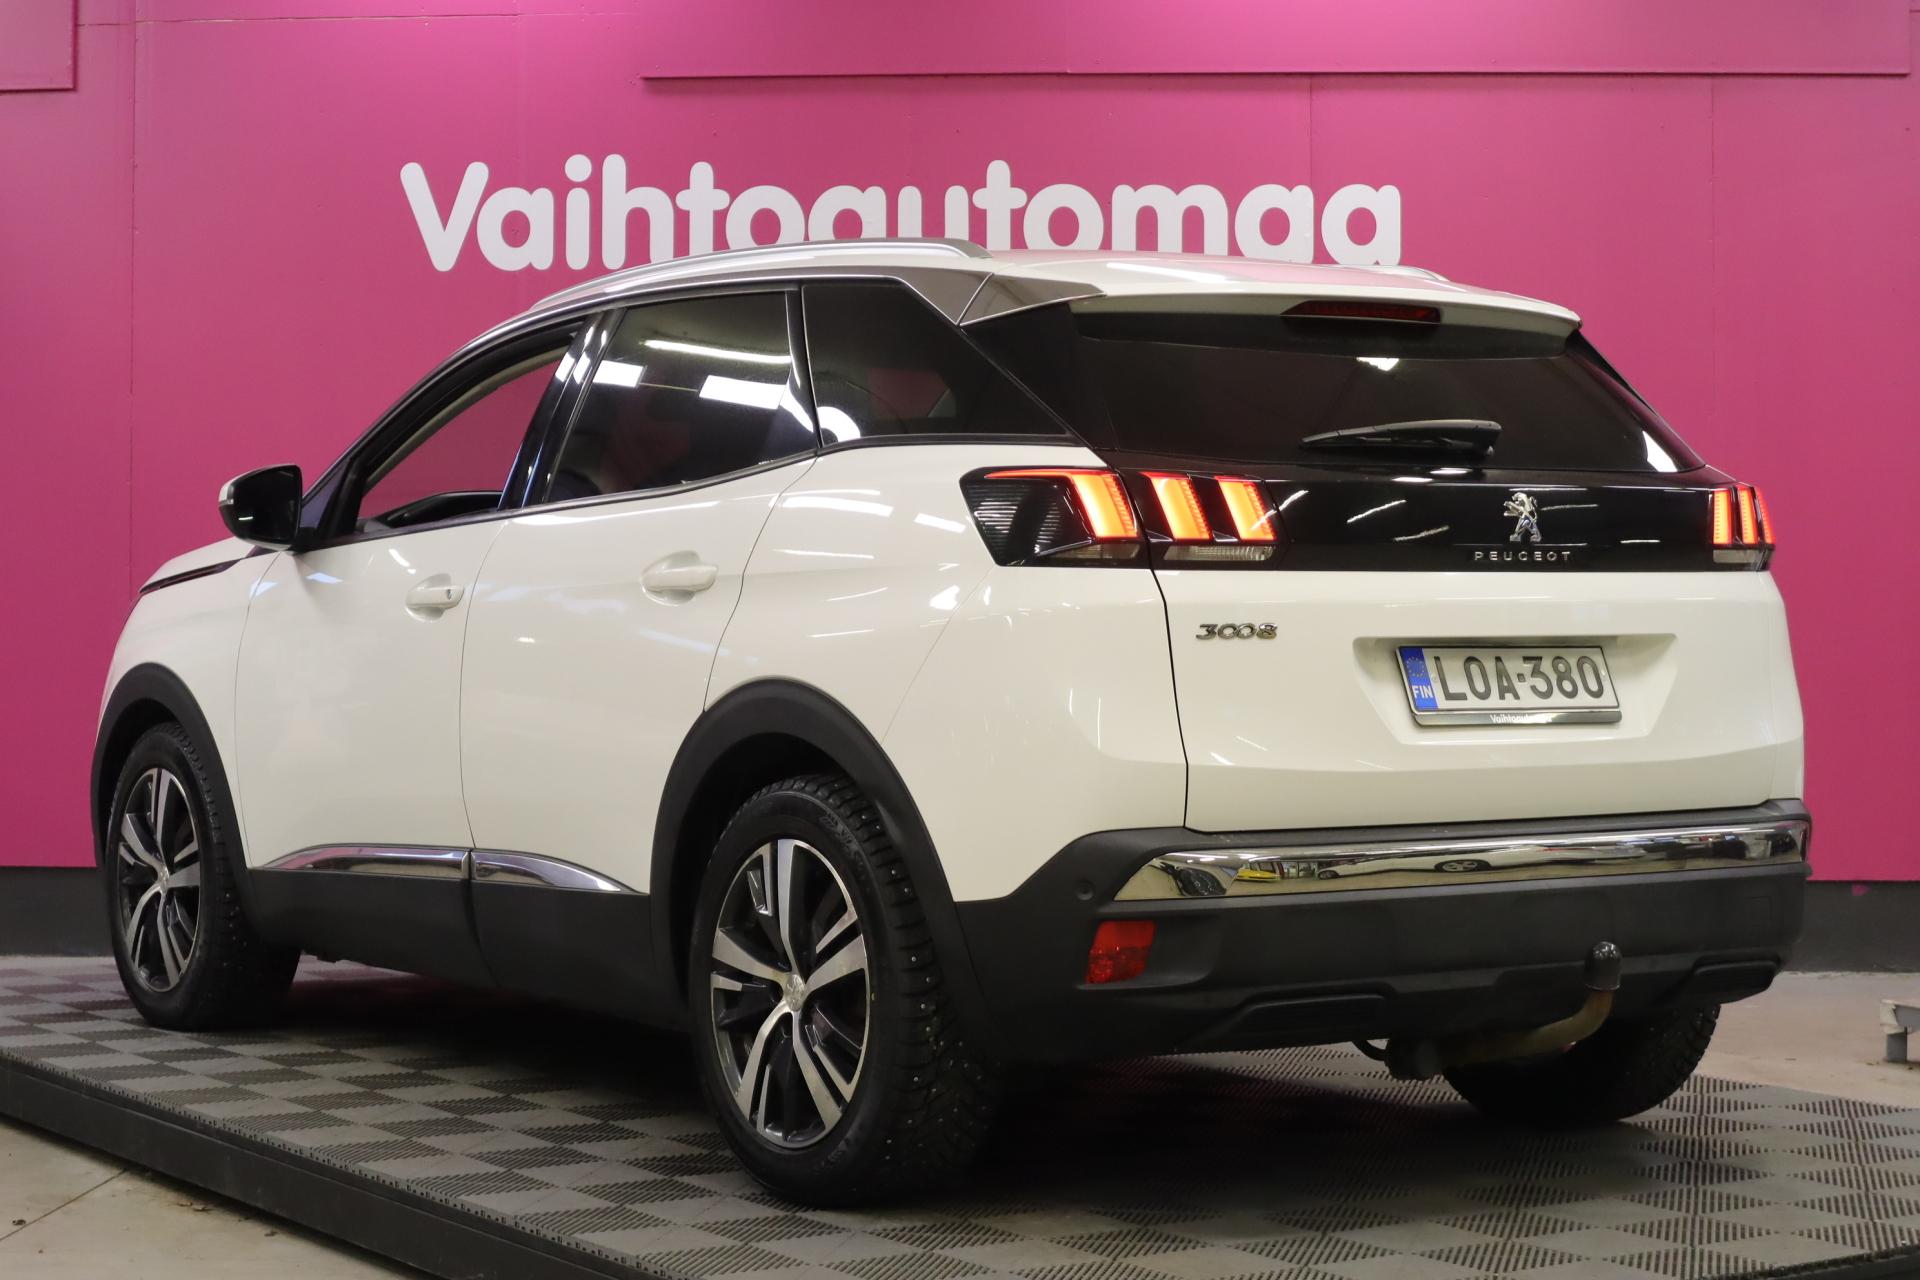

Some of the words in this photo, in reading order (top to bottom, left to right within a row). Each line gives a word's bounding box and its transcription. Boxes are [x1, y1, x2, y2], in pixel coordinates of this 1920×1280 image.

[1474, 551, 1571, 561] PEUGEOT
[1195, 623, 1278, 640] 3008
[1433, 655, 1604, 701] LOA-380
[1411, 684, 1433, 700] FIN
